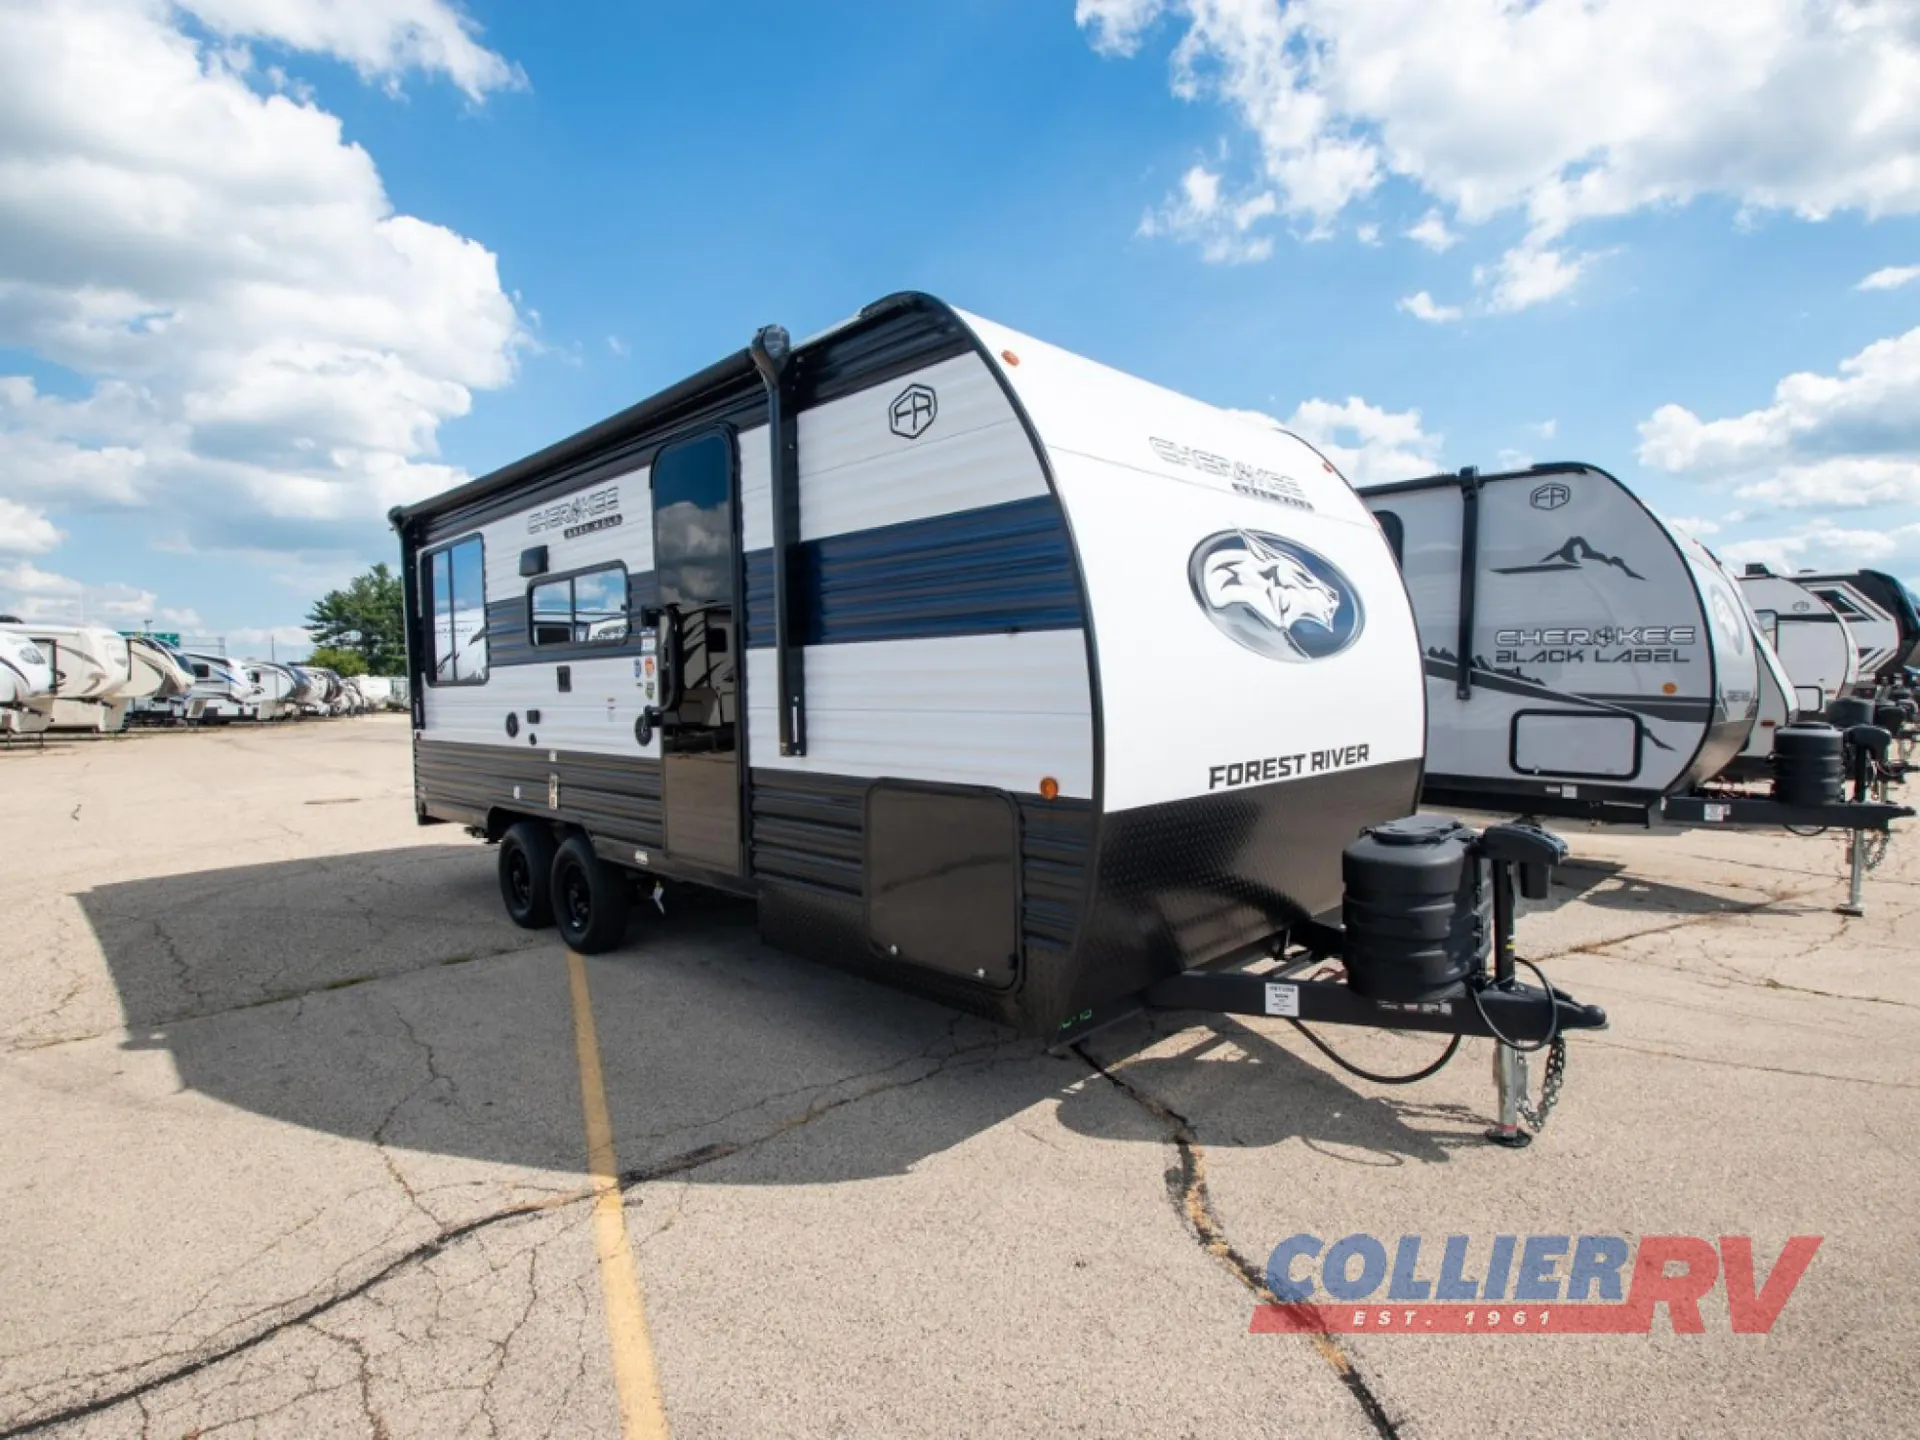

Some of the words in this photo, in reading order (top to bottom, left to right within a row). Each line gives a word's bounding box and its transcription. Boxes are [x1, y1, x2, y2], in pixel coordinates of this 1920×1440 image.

[1495, 625, 1696, 648] CHEROKEE
[1495, 649, 1584, 663] BLACK
[1594, 649, 1691, 663] LABEL
[1209, 754, 1306, 790] FOREST
[1311, 743, 1370, 772] RIVER
